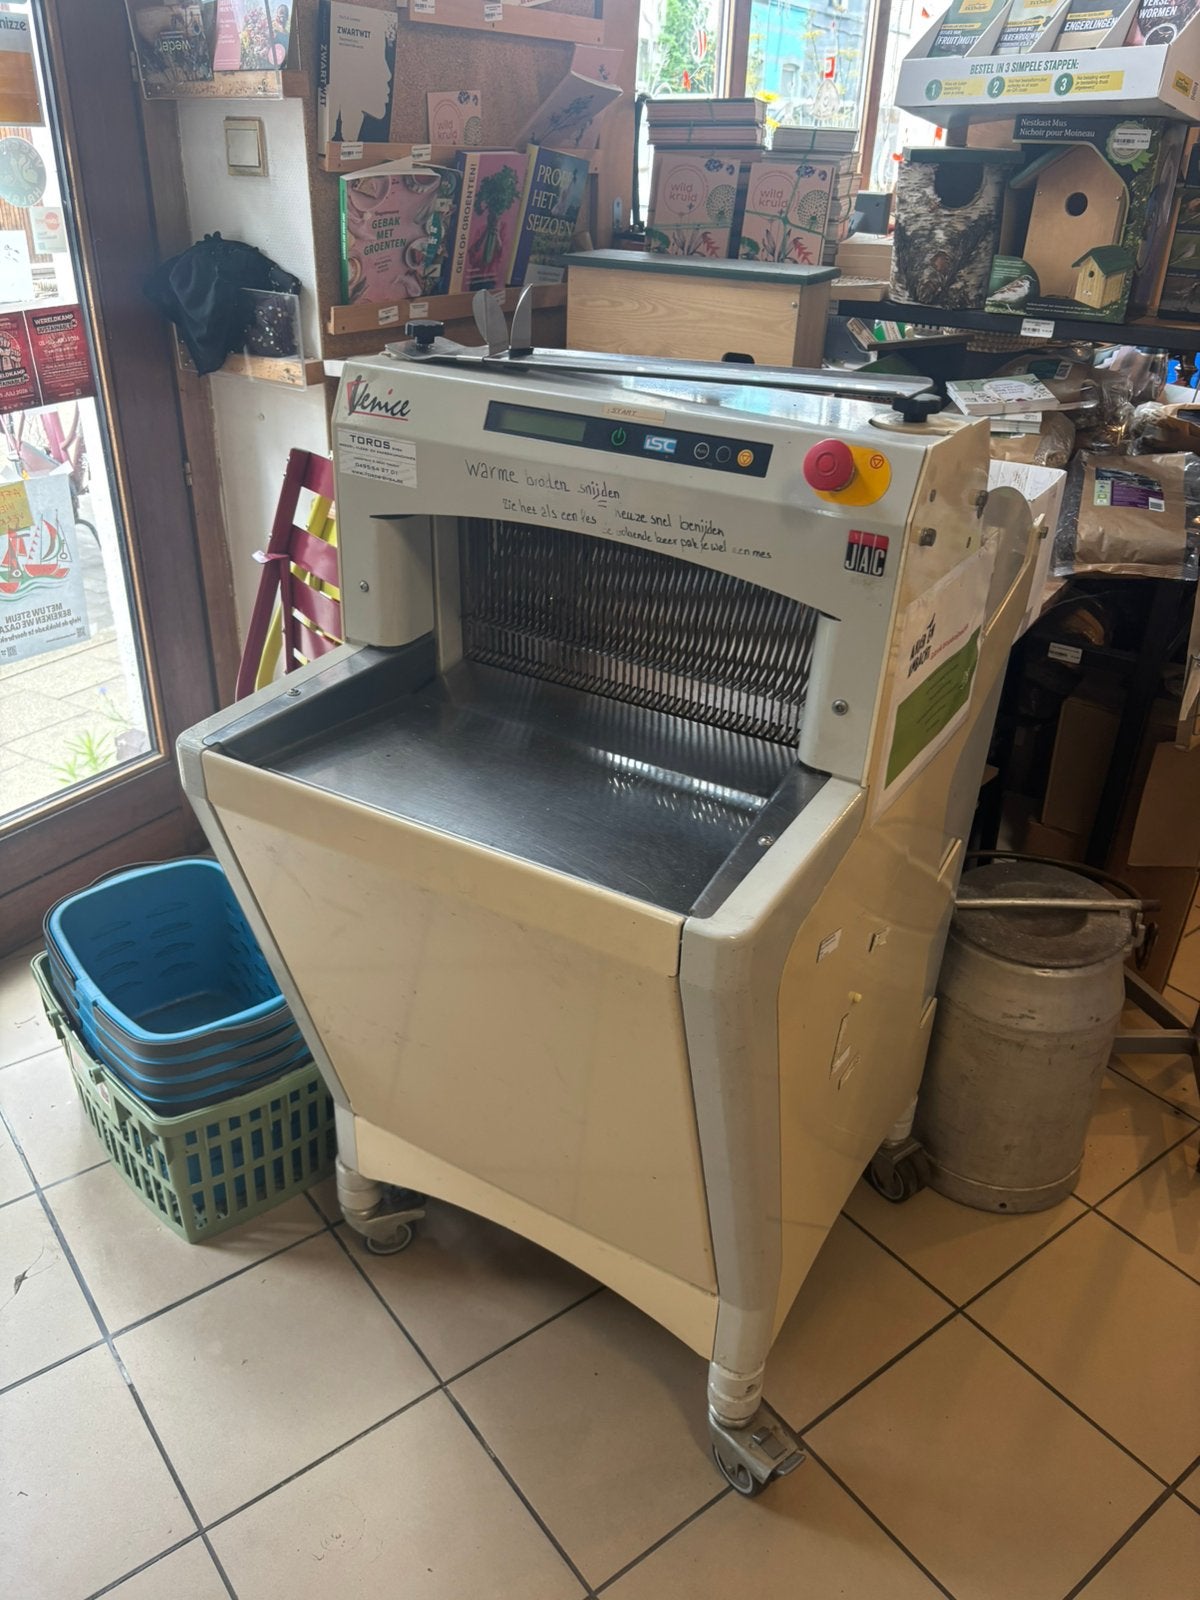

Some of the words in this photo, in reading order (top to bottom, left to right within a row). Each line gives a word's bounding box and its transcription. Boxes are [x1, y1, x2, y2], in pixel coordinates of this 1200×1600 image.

[1139, 6, 1178, 19] WORMEN
[336, 25, 371, 39] ZWARTWIT
[970, 63, 995, 75] BESTEL
[995, 64, 1004, 73] IN
[1005, 62, 1011, 73] 3
[1011, 60, 1042, 73] SIMPELE
[1043, 58, 1079, 71] STAPPEN:
[992, 80, 1000, 94] 2
[1060, 77, 1067, 91] 3
[1020, 118, 1051, 127] Nestkast
[1052, 118, 1067, 127] Mus
[1019, 127, 1046, 136] Nichoir
[1045, 130, 1063, 138] pour
[1064, 129, 1095, 137] Moineau
[670, 182, 693, 193] wild
[760, 188, 783, 199] wild
[531, 189, 557, 211] HET
[371, 216, 401, 229] GEBAK
[376, 228, 395, 240] MET
[363, 238, 407, 256] GROENTEN
[347, 375, 411, 417] Venice
[350, 434, 391, 449] TOROS
[465, 459, 519, 483] Warme
[577, 481, 620, 500] snijden
[560, 511, 578, 521] een
[650, 514, 672, 528] snel
[710, 540, 727, 552] wel
[752, 550, 772, 559] mes
[845, 542, 886, 576] JAC
